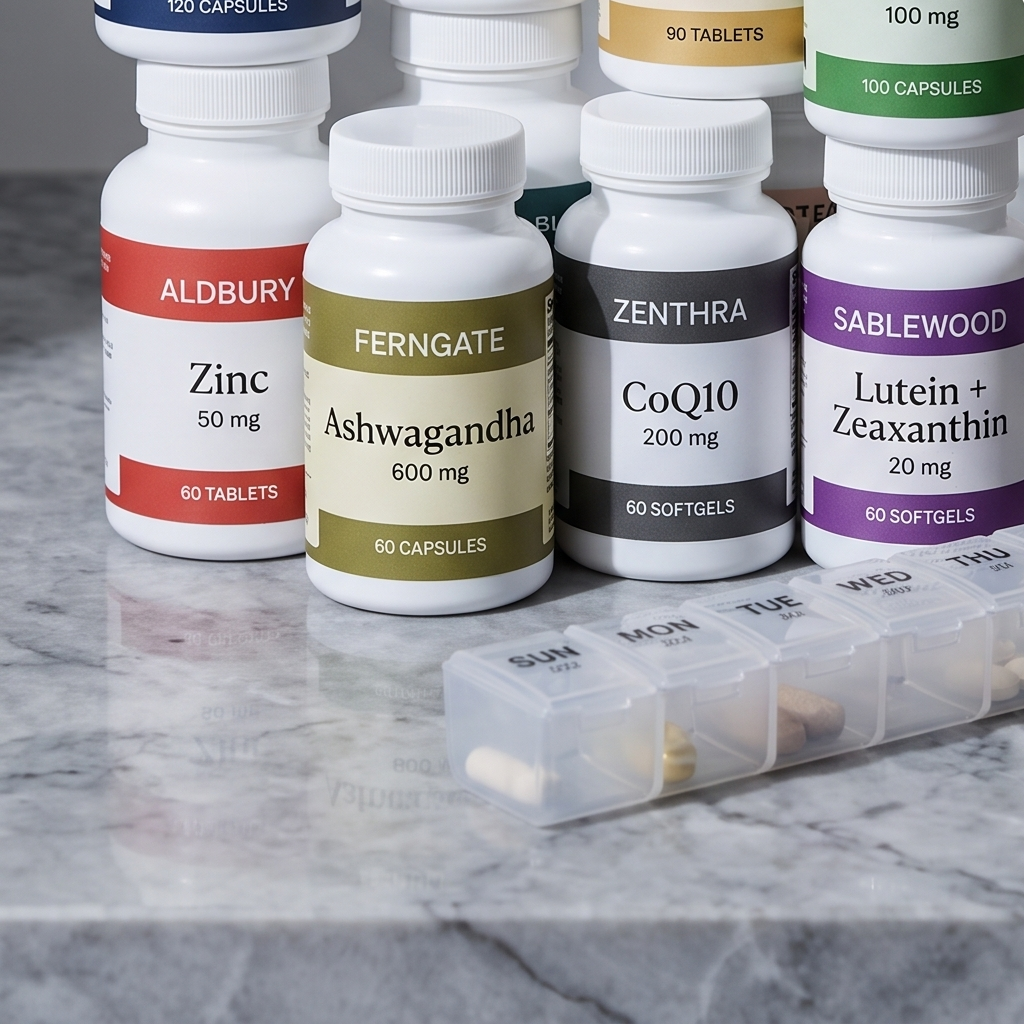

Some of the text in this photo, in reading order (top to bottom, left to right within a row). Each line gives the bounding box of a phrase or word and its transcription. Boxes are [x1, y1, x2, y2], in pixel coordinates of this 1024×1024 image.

[886, 7, 959, 29] 100 mg
[667, 27, 763, 42] 90 TABLETS
[862, 79, 981, 95] 100 CAPSULES
[161, 277, 295, 304] ALDBURY
[614, 298, 747, 325] ZENTHRA
[834, 306, 1006, 338] SABLEWOOD
[356, 327, 504, 357] FERNGATE
[190, 363, 268, 394] Zinc
[855, 372, 986, 405] Lutein +
[623, 380, 738, 420] CoQ10
[198, 411, 260, 432] 50 mg
[324, 407, 534, 455] Ashwagandha
[833, 404, 1007, 443] Zeaxanthin
[643, 428, 718, 449] 200 mg
[392, 463, 469, 484] 600 mg
[889, 457, 951, 479] 20 mg
[181, 485, 278, 501] 60 TABLETS
[627, 499, 734, 516] 60 SOFTGELS
[866, 507, 975, 524] 60 SOFTGELS
[375, 538, 486, 555] 60 CAPSULES
[945, 547, 1011, 568] THU
[836, 570, 912, 593] WED
[736, 595, 803, 616] TUE
[617, 619, 700, 643] MON
[508, 646, 581, 668] SUN
